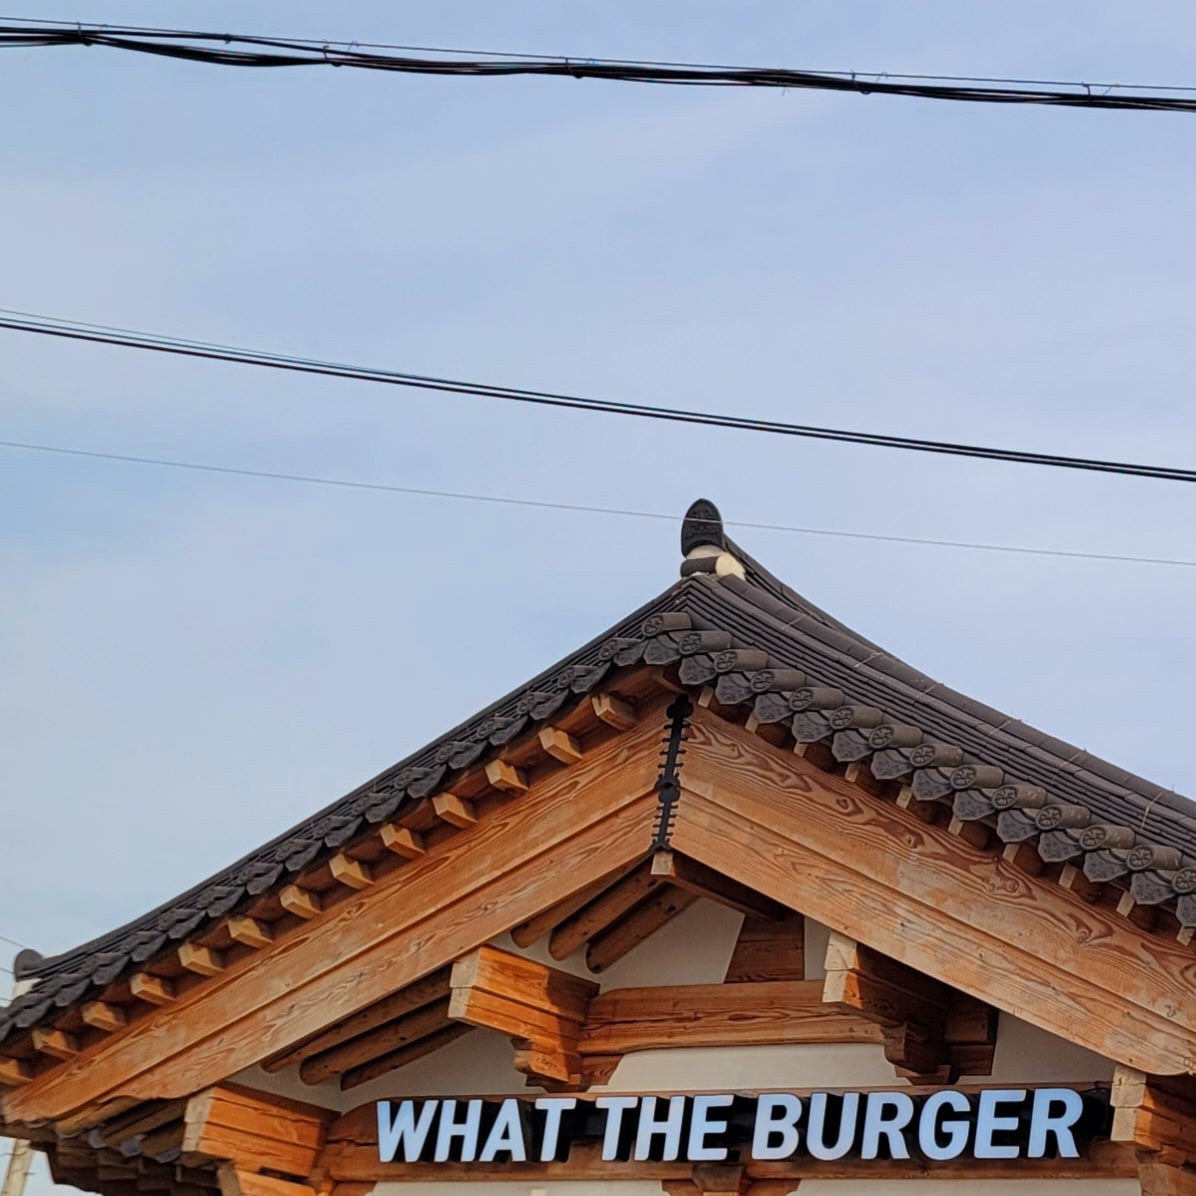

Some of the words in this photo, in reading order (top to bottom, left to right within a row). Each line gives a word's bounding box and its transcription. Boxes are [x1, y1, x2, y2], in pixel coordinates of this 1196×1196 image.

[375, 1096, 577, 1163] WHAT
[595, 1093, 735, 1162] THE
[750, 1088, 1084, 1161] BURGER
